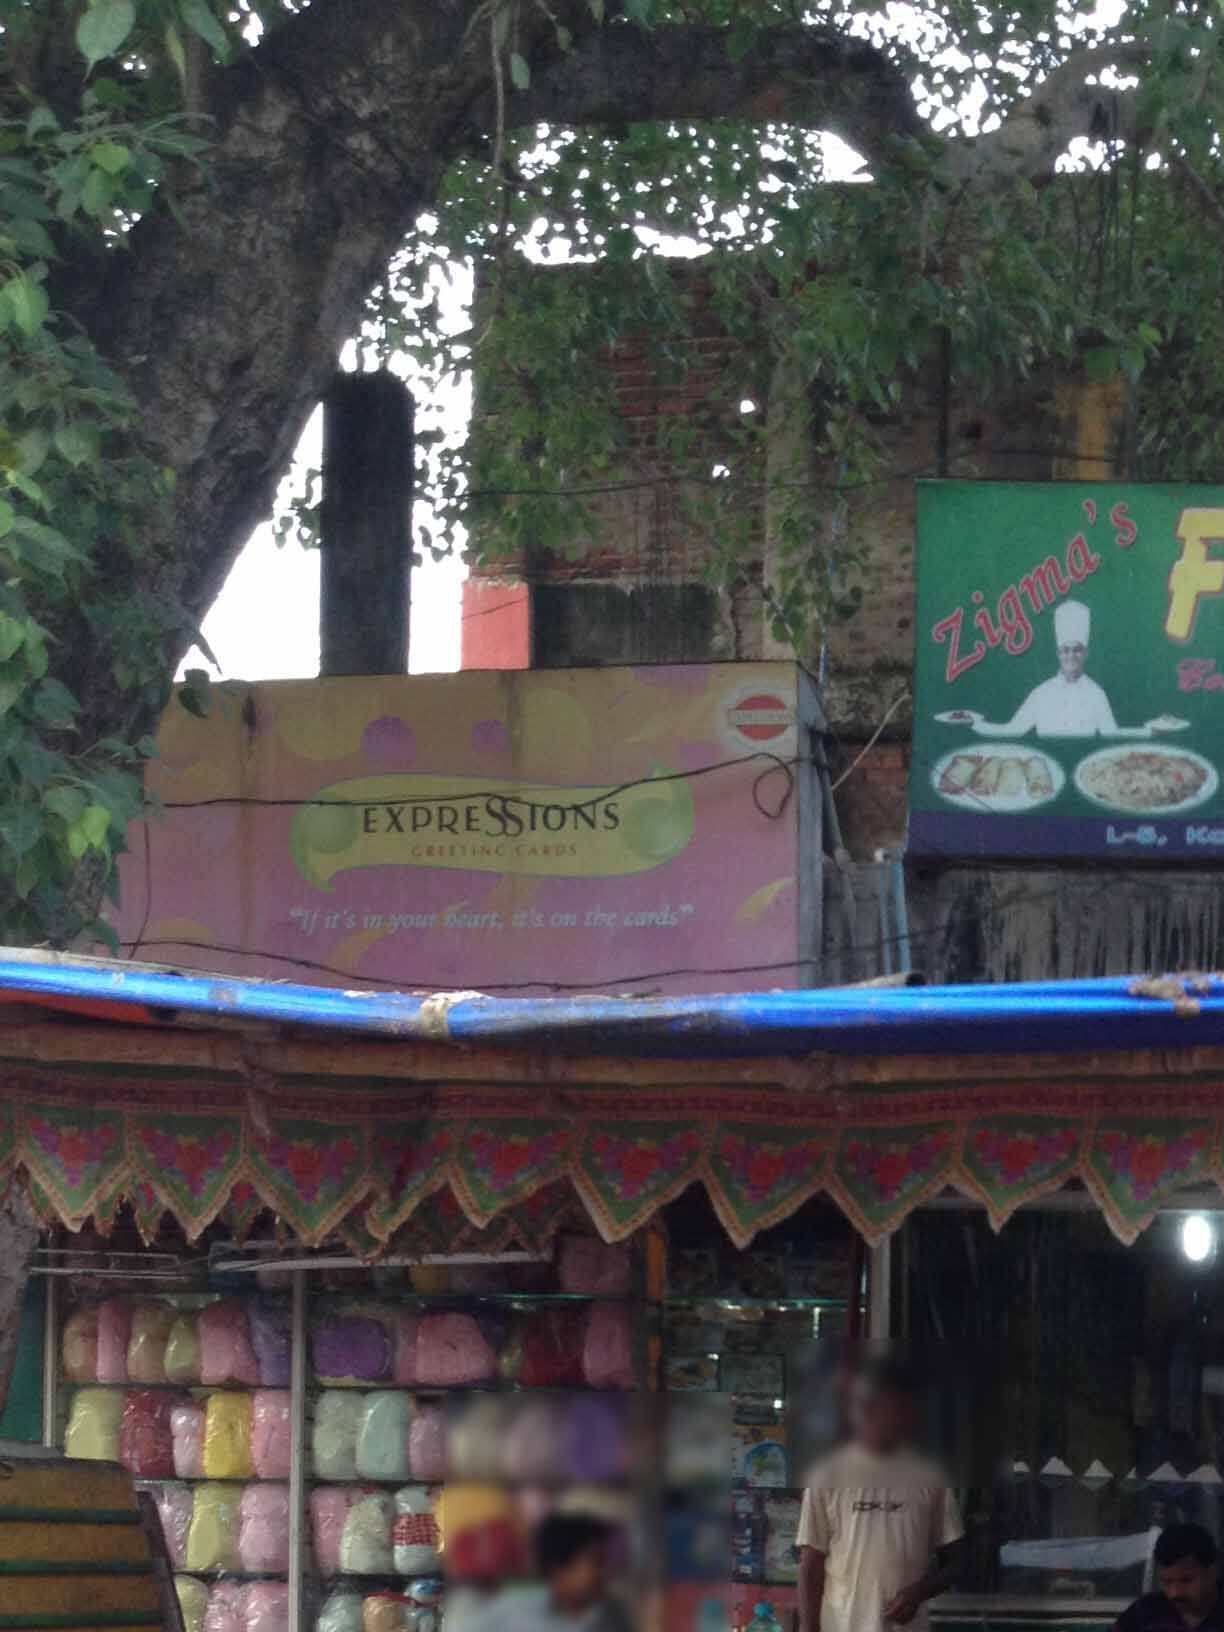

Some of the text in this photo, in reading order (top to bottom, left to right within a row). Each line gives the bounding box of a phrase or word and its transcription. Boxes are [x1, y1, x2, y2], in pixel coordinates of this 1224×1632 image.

[932, 499, 1137, 683] Zigma's
[362, 797, 622, 838] EXPRESSIONS
[411, 843, 578, 858] GREETING CARDS
[547, 914, 578, 929] on
[583, 906, 617, 929] the
